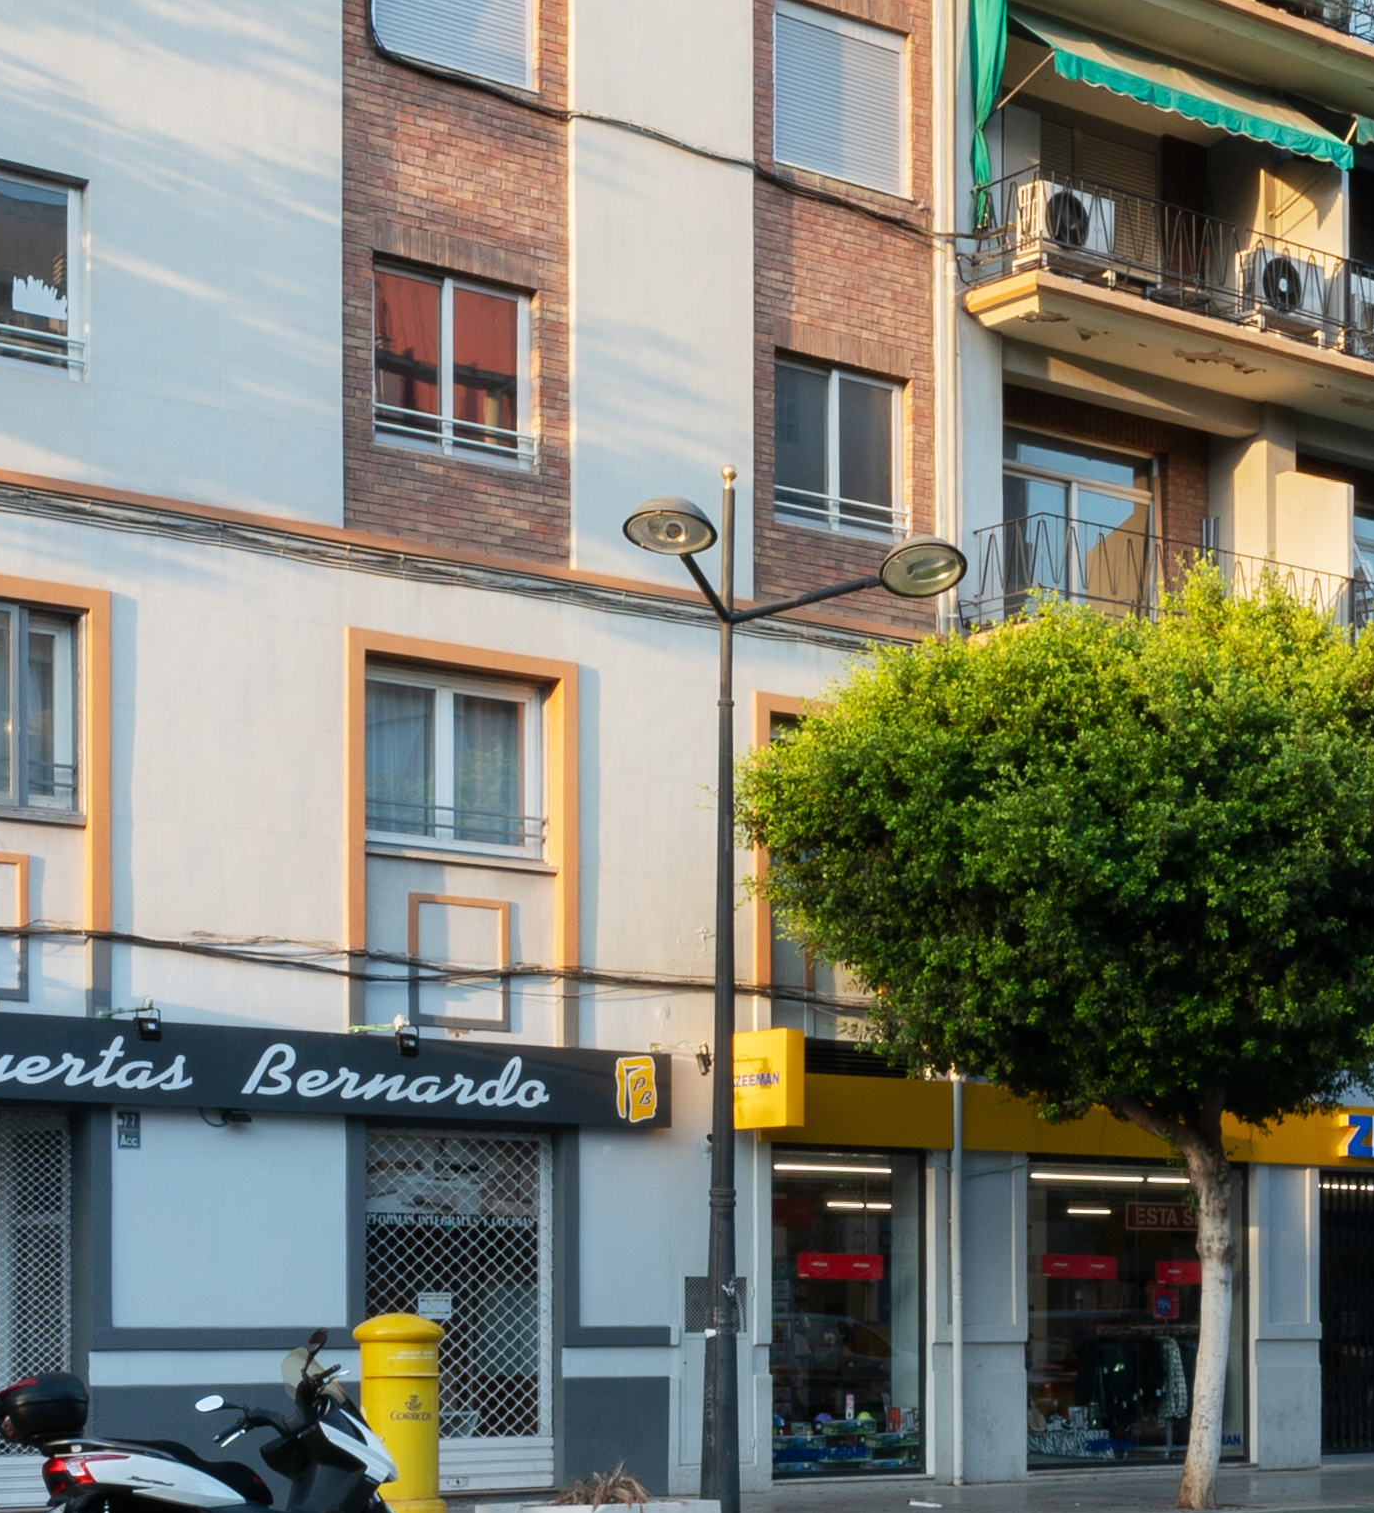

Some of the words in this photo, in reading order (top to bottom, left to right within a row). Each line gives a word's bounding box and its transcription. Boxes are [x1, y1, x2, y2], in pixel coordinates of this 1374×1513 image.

[241, 1043, 550, 1110] Bernardo
[633, 1076, 646, 1092] P
[734, 1072, 779, 1087] ZEEMAN
[639, 1090, 653, 1105] B
[122, 1114, 136, 1127] 77
[1136, 1207, 1177, 1225] ESTA
